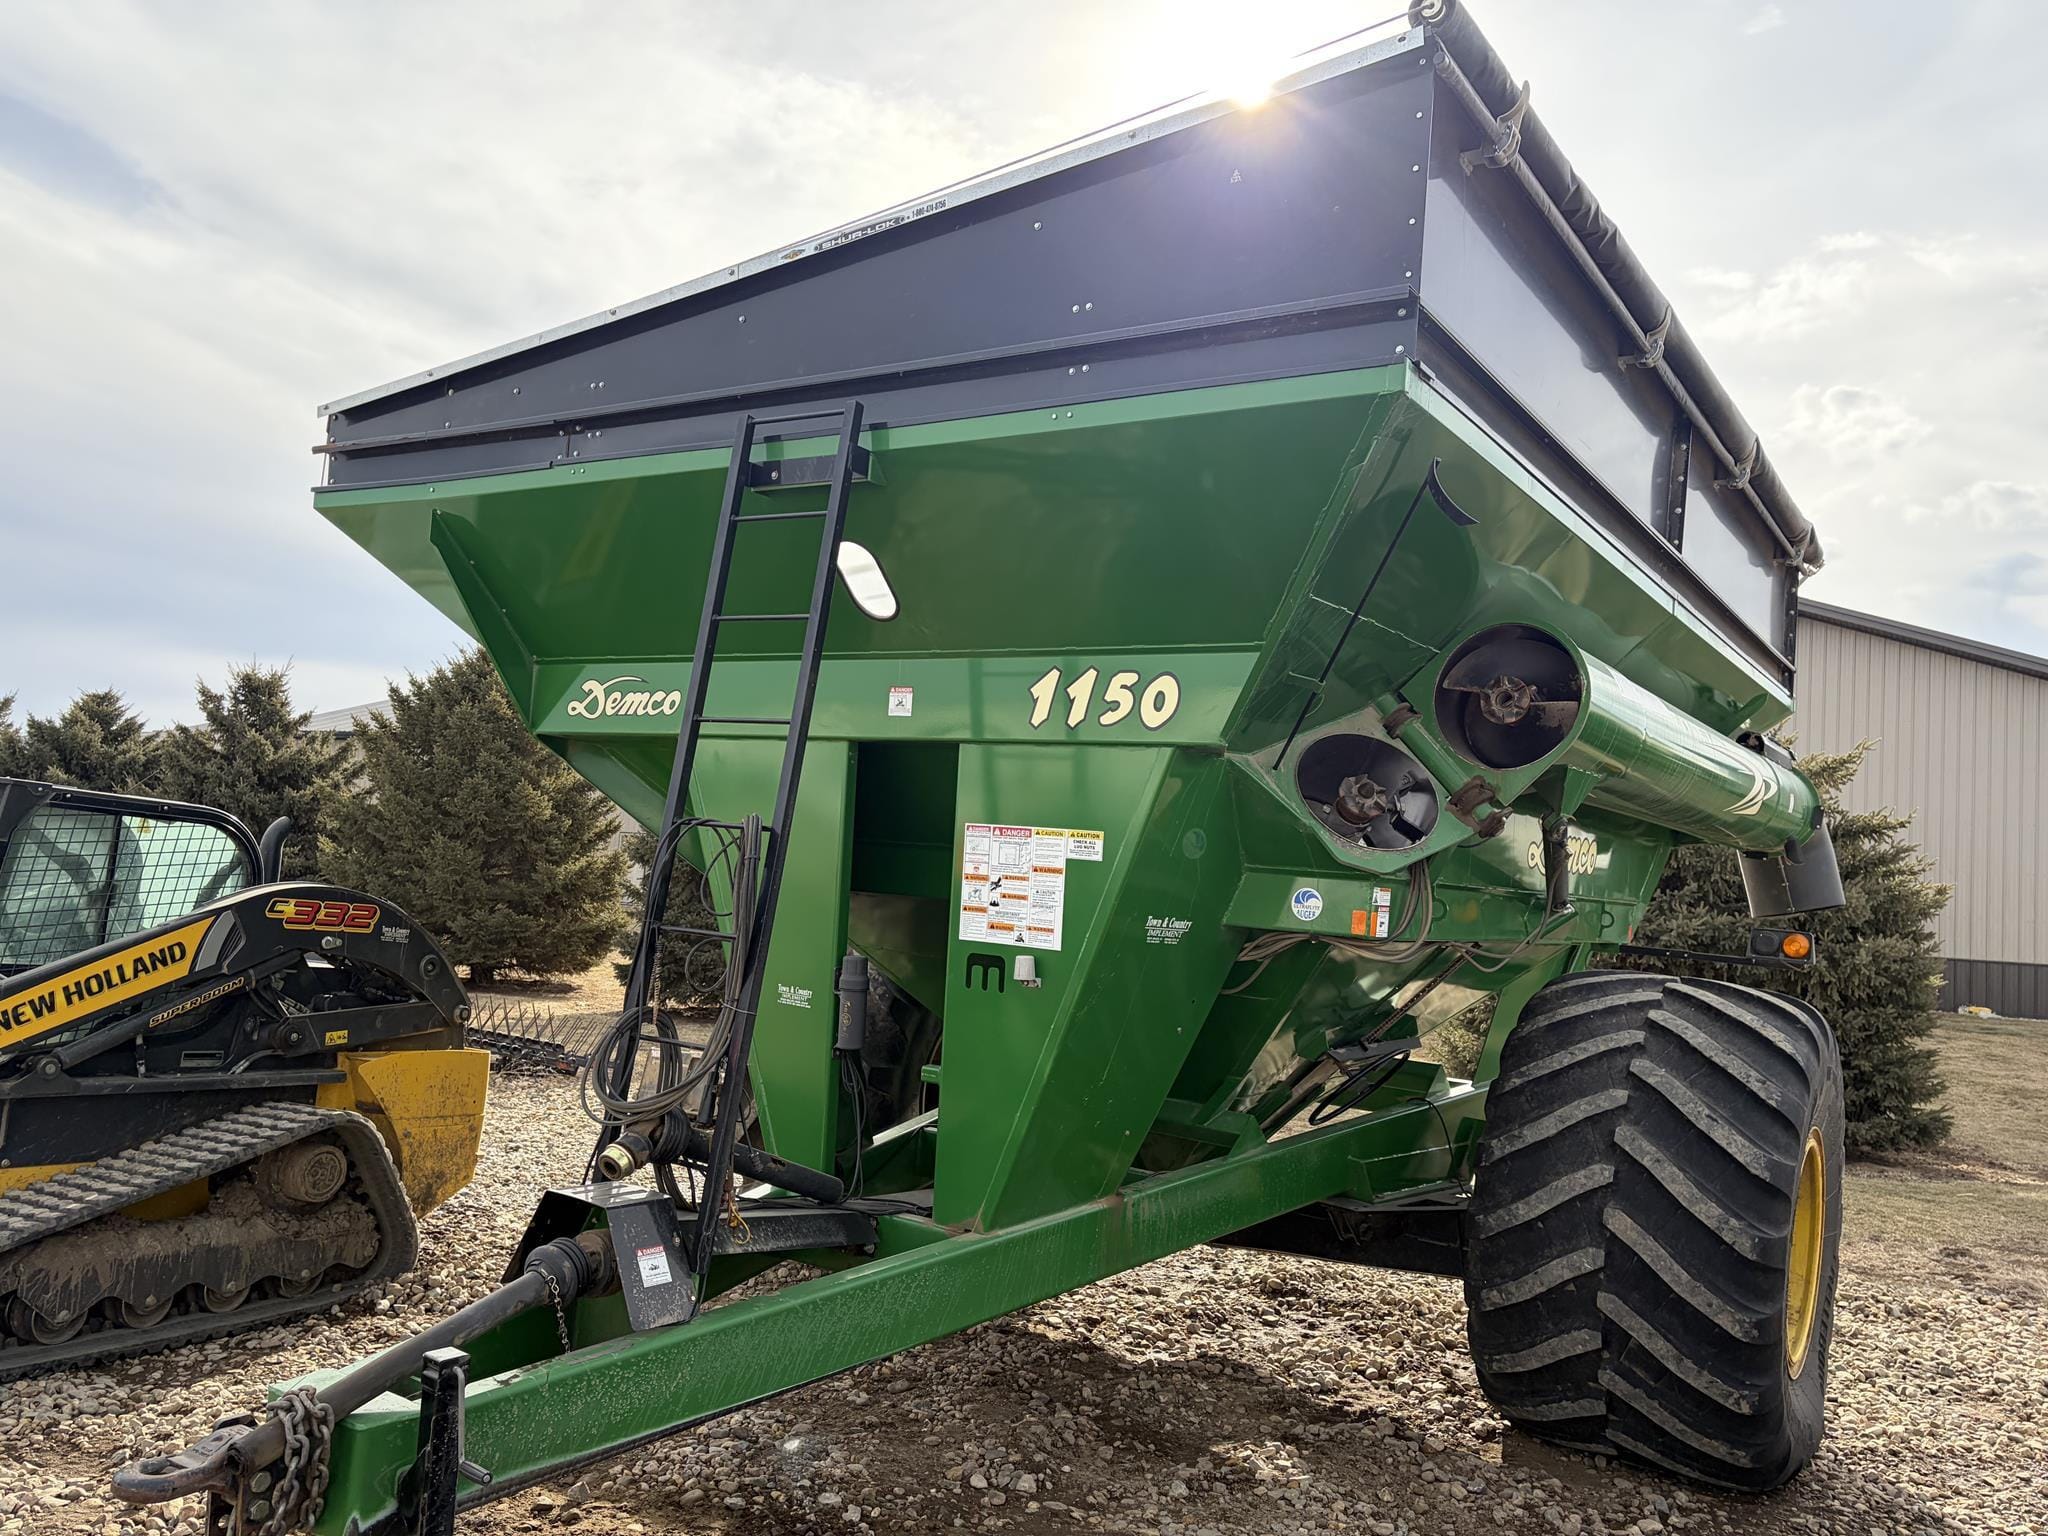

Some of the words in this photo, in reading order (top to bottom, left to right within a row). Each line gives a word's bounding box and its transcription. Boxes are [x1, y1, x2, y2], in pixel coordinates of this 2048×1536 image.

[567, 674, 682, 720] Demco
[1028, 665, 1181, 731] 1150
[1002, 829, 1030, 837] DANGER
[1039, 866, 1063, 874] WARNING
[265, 897, 380, 934] C332
[1146, 916, 1162, 927] Town
[1169, 917, 1192, 931] Country
[1147, 930, 1183, 938] IMPLEMENT
[0, 990, 56, 1032] NEW
[62, 941, 187, 1006] HOLLAND
[149, 997, 200, 1027] SUPER
[201, 977, 244, 1003] BOOM
